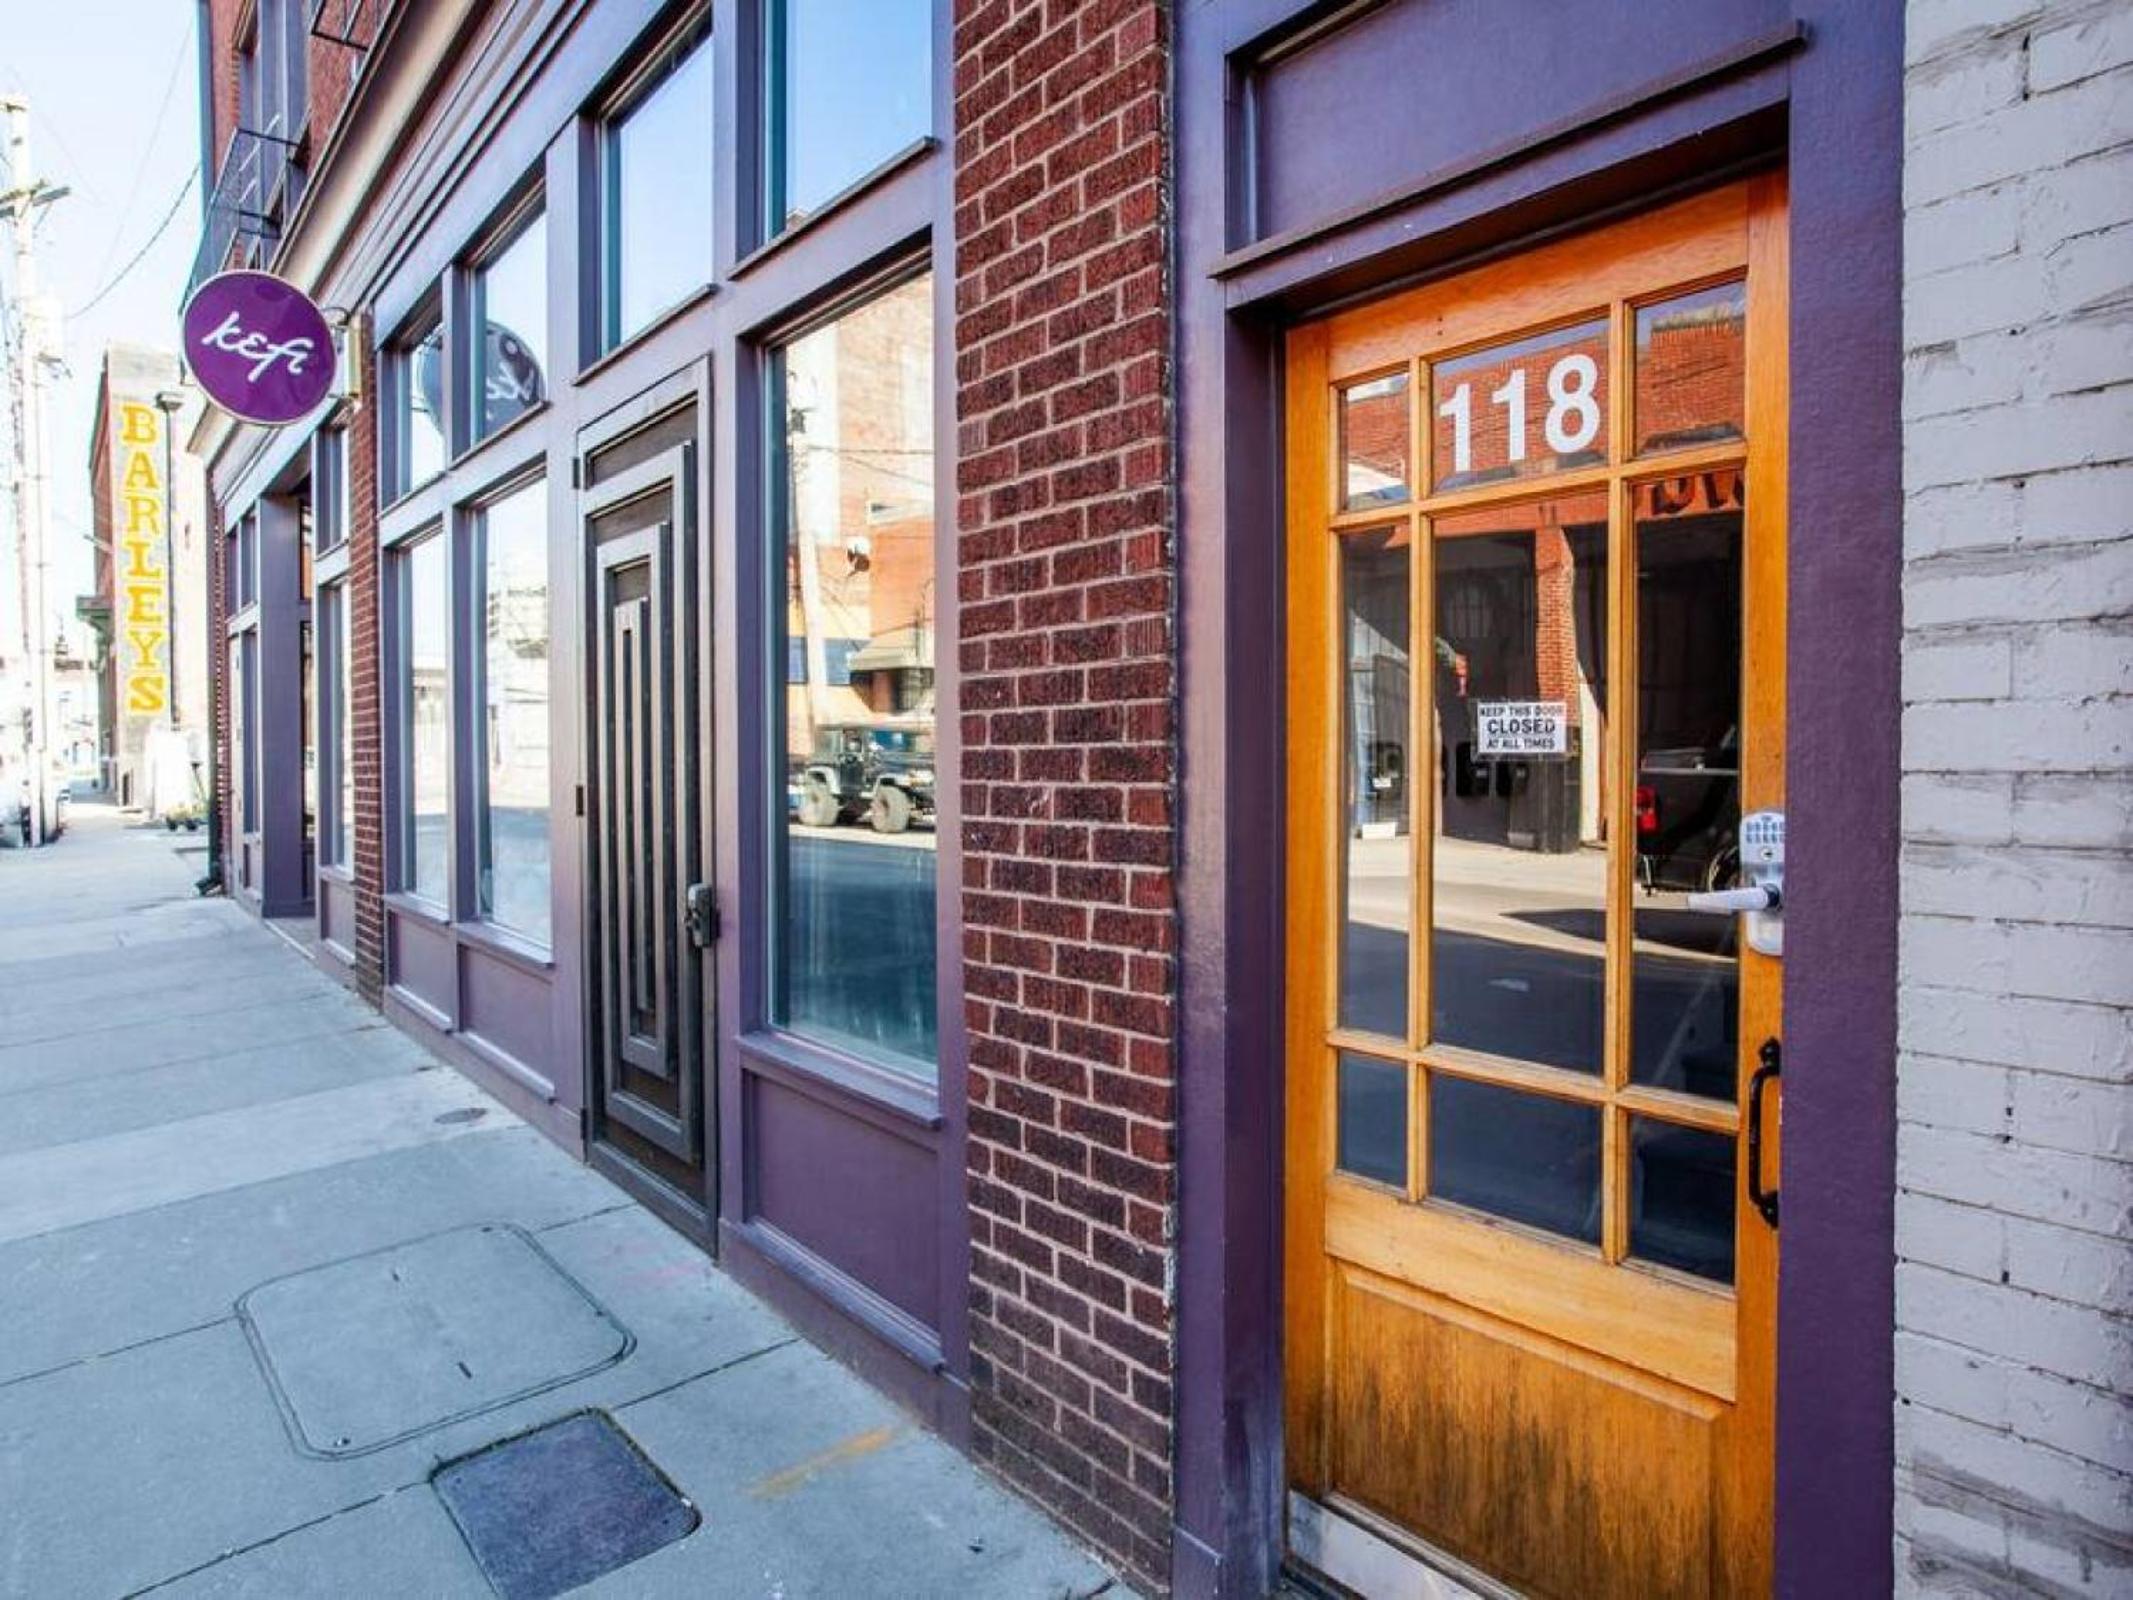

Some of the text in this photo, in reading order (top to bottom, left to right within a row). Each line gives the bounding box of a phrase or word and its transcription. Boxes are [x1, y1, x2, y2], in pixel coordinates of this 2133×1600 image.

[201, 310, 315, 383] kefi
[1439, 353, 1600, 472] 118
[119, 403, 166, 714] BARLEYS
[1480, 704, 1564, 717] KEEP THIS DOOR
[1487, 718, 1556, 735] CLOSED
[1486, 737, 1556, 750] AT ALL TIMES
